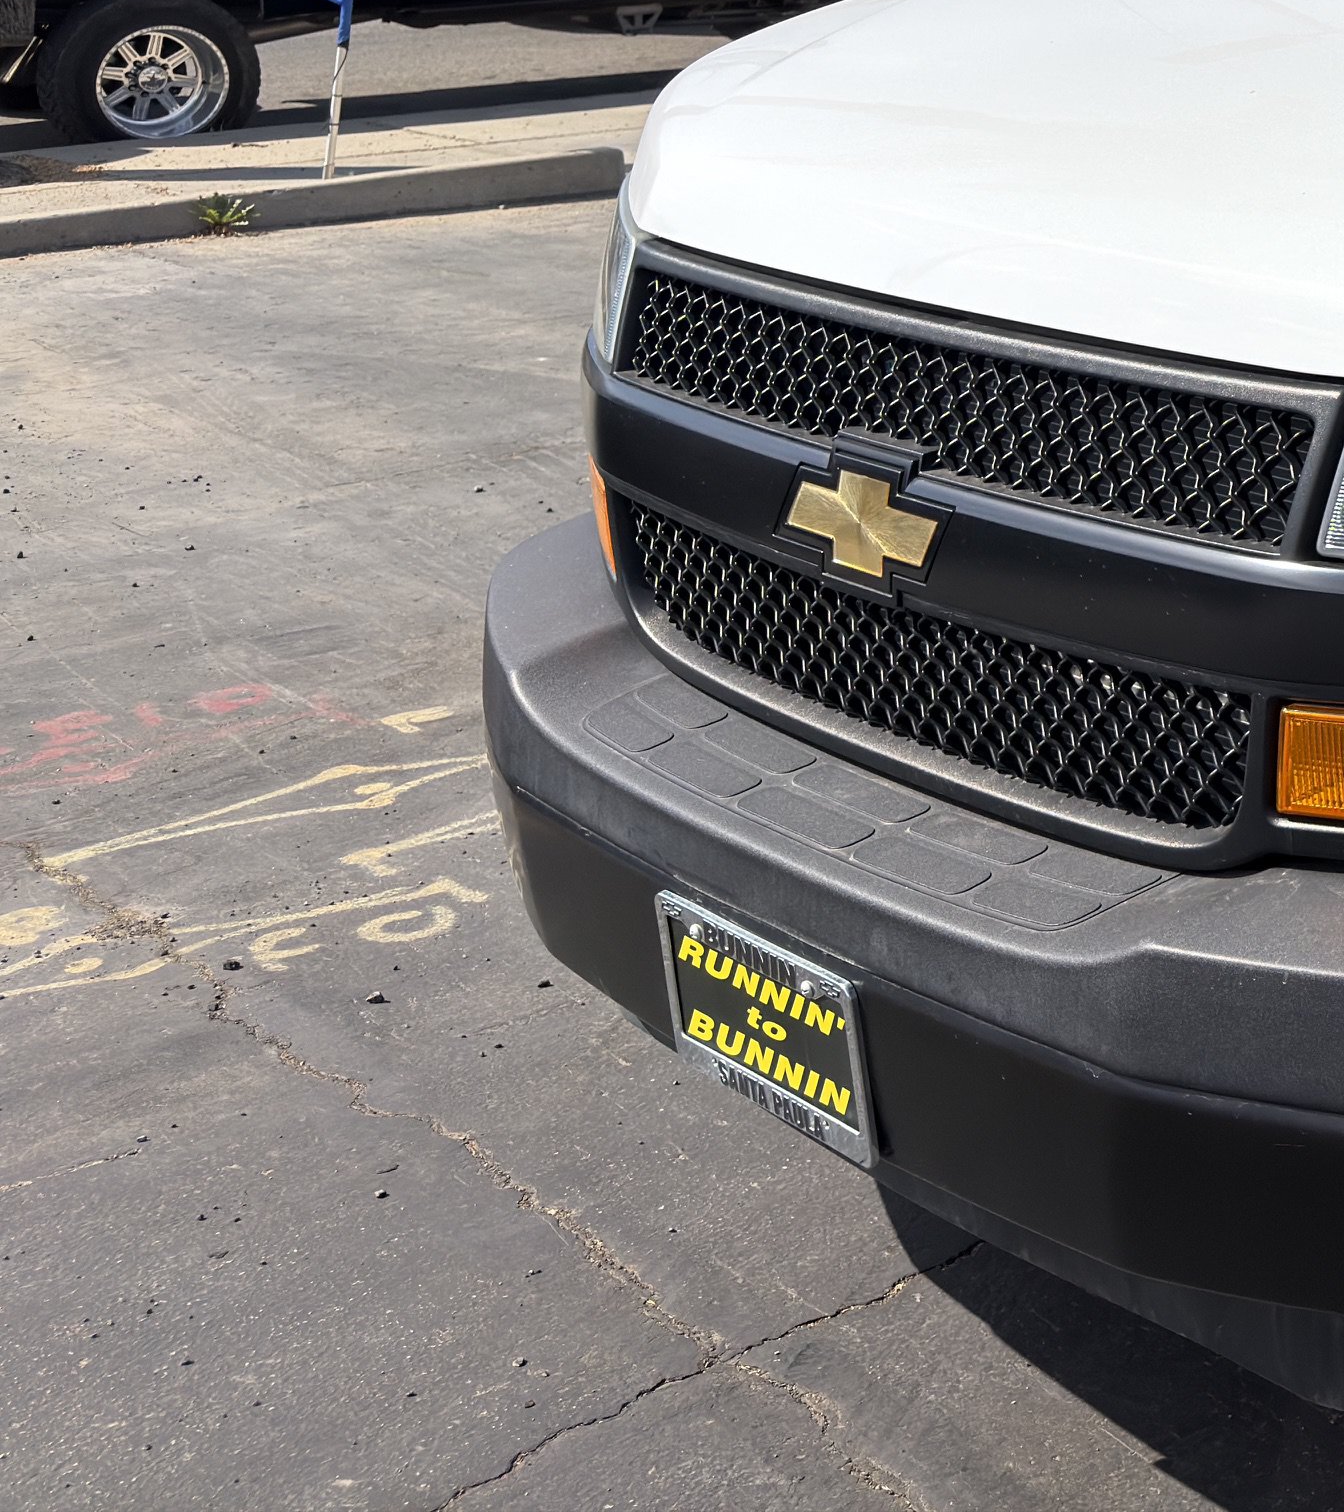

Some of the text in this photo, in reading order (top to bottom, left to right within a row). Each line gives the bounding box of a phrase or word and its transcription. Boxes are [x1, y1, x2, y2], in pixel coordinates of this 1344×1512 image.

[677, 935, 847, 1037] RUNNIN'
[702, 918, 797, 989] BUNNIN
[746, 1006, 787, 1042] to
[687, 1008, 851, 1116] BUNNIN
[771, 1087, 826, 1142] PAULA
